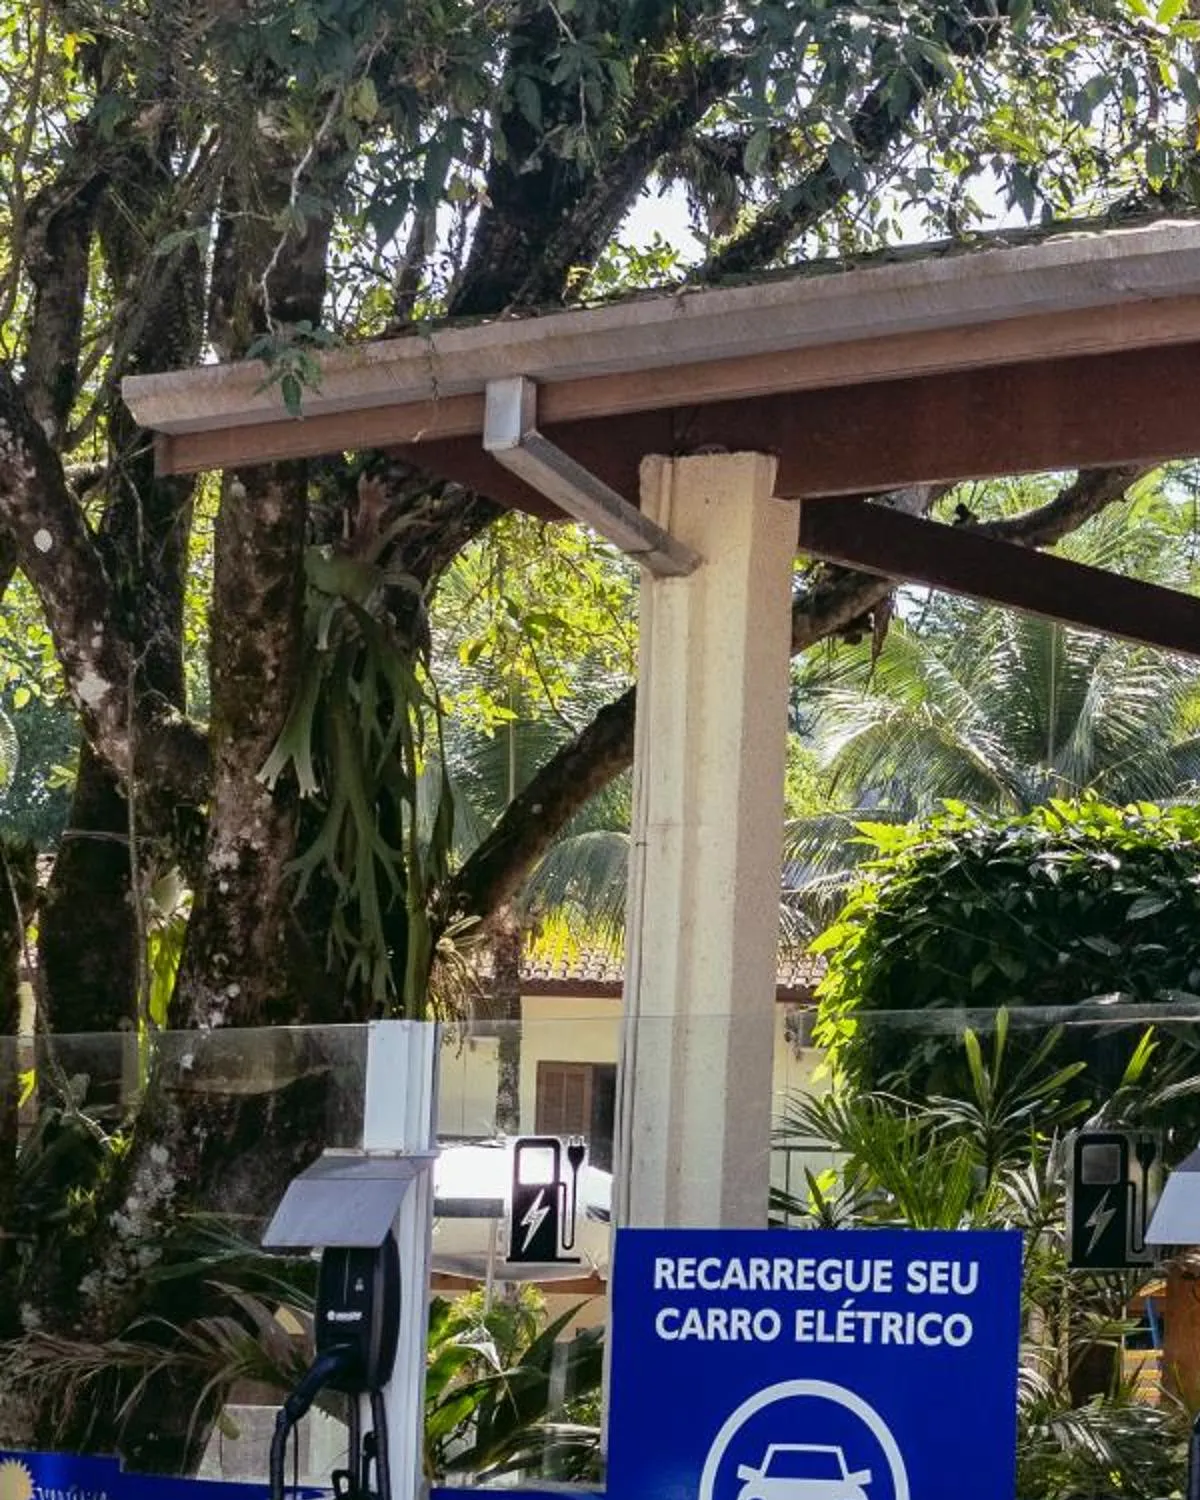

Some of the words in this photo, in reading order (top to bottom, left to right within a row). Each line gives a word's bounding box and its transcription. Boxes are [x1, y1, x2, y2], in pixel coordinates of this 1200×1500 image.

[653, 1257, 893, 1294] RECARREGUE
[906, 1259, 979, 1296] SEU
[655, 1307, 781, 1342] CARRO
[794, 1299, 974, 1348] ELÉTRICO
